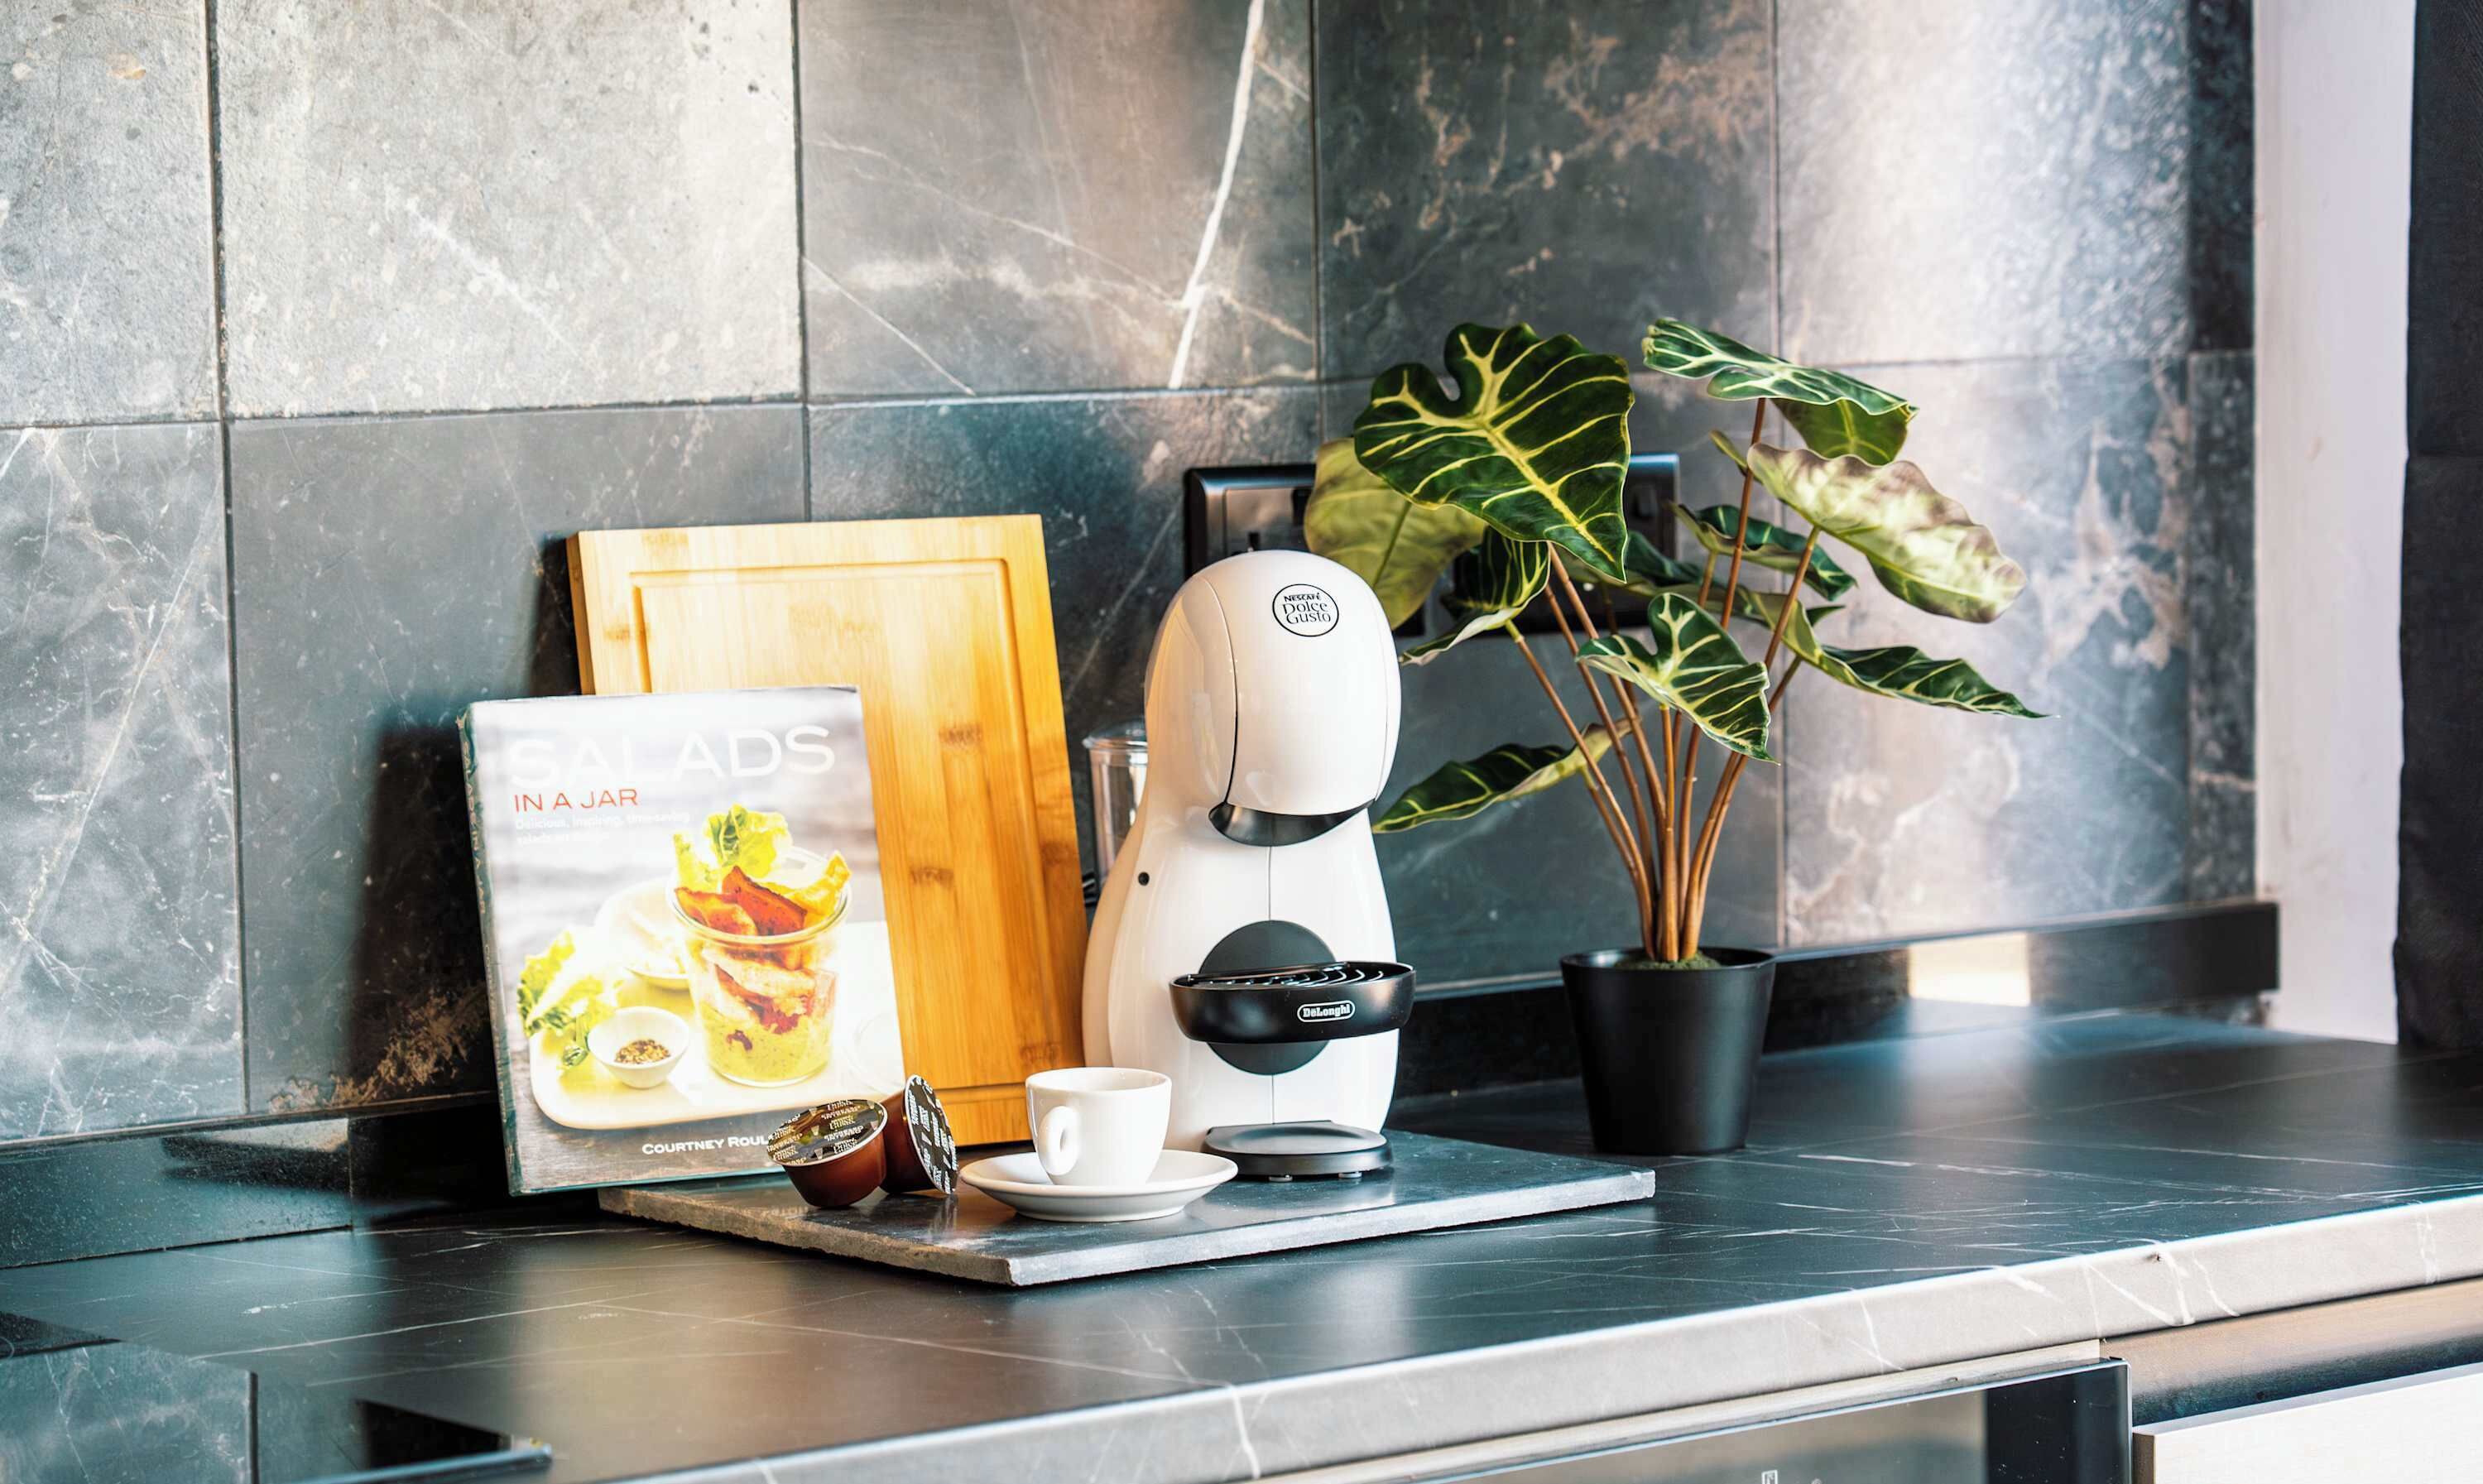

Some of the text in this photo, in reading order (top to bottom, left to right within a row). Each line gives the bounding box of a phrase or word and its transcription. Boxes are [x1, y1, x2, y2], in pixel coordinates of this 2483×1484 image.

[1283, 601, 1328, 614] Dolce
[1285, 612, 1332, 624] Gusto
[508, 725, 836, 787] SALADS
[514, 789, 638, 813] IN A JAR
[641, 1139, 725, 1155] COURTNEY
[728, 1136, 769, 1148] ROUL
